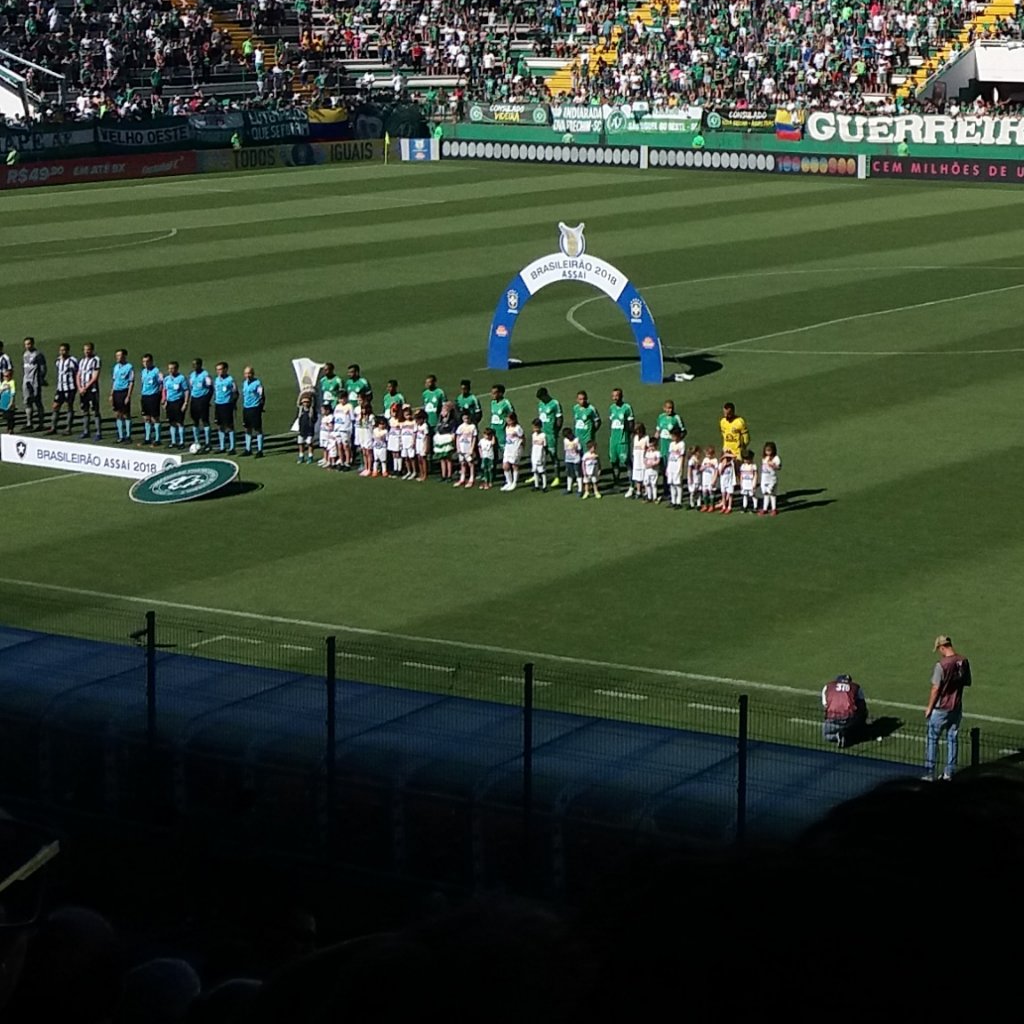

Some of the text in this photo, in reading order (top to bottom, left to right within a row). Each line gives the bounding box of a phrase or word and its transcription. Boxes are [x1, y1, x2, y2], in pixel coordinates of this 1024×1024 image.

[728, 111, 768, 119] CONSULADO
[101, 128, 143, 144] VELHO
[147, 125, 188, 143] OESTE
[233, 147, 276, 169] TODOS
[331, 142, 373, 162] IGUAIS
[873, 160, 902, 173] CEM
[911, 160, 980, 177] MILHÕES
[988, 164, 1007, 177] DE
[530, 259, 618, 286] BRASILEIRÃO 2018
[36, 447, 101, 467] BRASILEIRÃO
[133, 461, 157, 474] 2018
